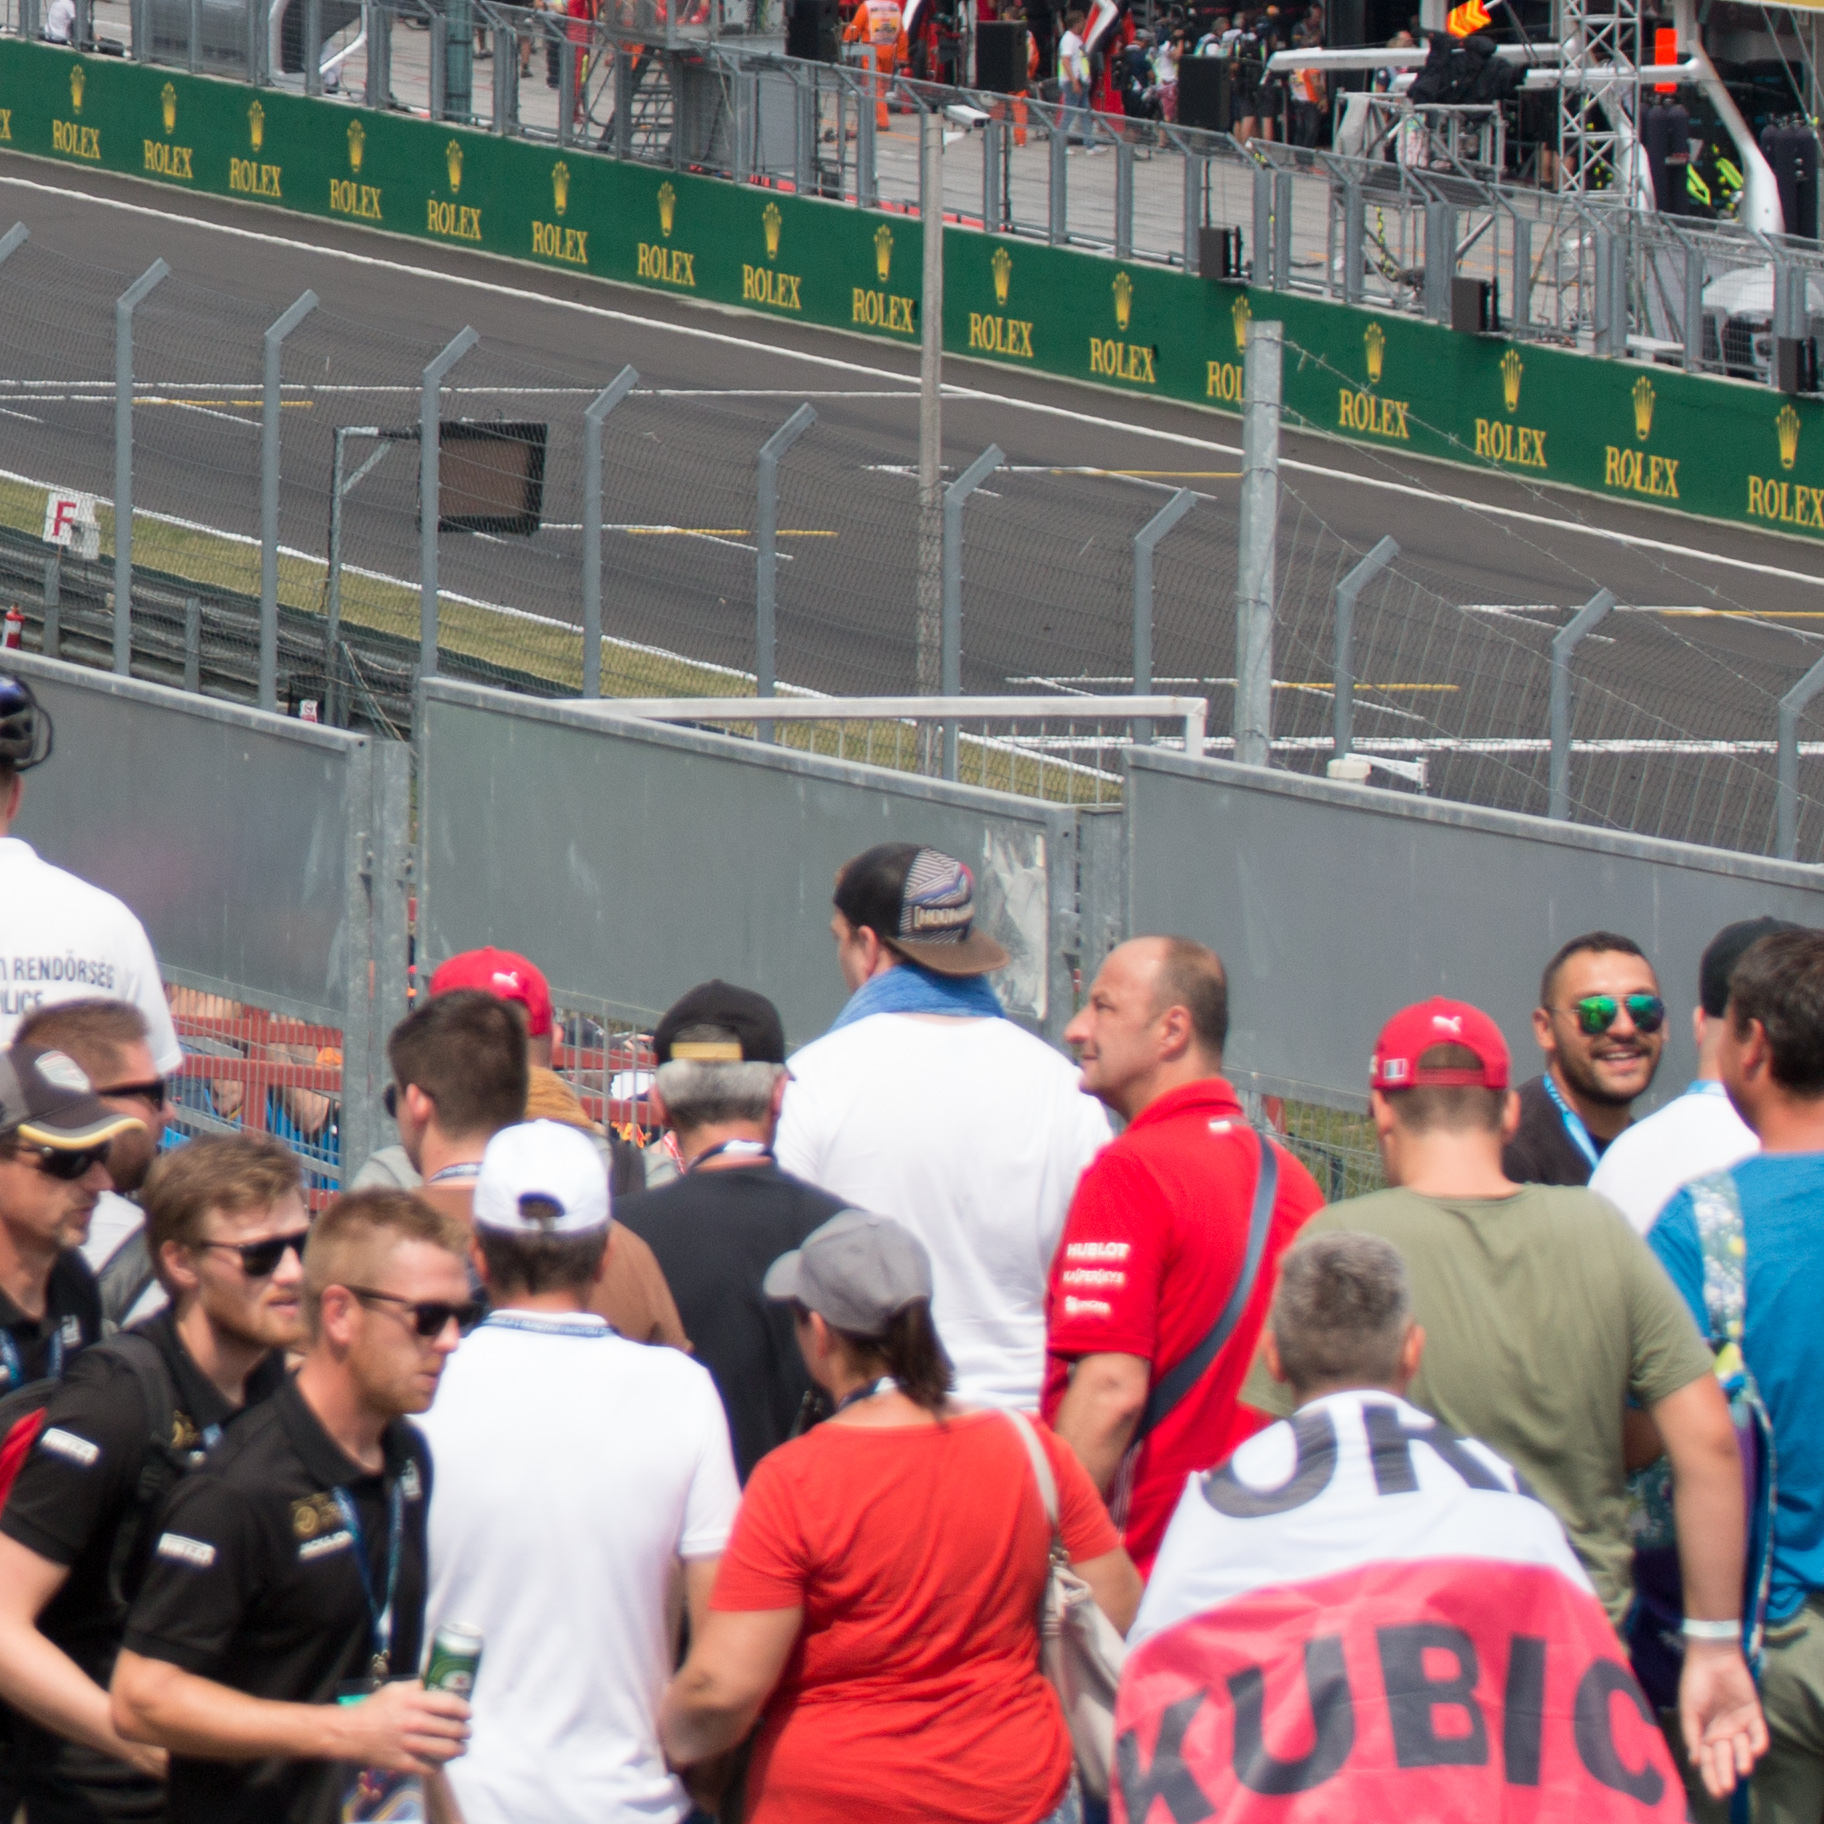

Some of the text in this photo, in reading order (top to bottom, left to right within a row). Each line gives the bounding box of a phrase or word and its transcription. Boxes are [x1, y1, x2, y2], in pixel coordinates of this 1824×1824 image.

[52, 119, 102, 160] ROLEX
[143, 139, 194, 179] ROLEX
[229, 157, 282, 198] ROLEX
[330, 178, 383, 220] ROLEX
[427, 199, 483, 241] ROLEX
[532, 220, 589, 265] ROLEX
[637, 242, 696, 287] ROLEX
[742, 263, 802, 310] ROLEX
[852, 287, 915, 334] ROLEX
[969, 312, 1035, 358] ROLEX
[1090, 337, 1157, 384] ROLEX
[1206, 360, 1243, 401] ROL
[1338, 388, 1410, 440] ROLEX
[1474, 417, 1548, 469] ROLEX
[1604, 445, 1681, 499] ROLEX
[52, 500, 77, 537] F
[1747, 474, 1824, 530] ROLEX
[14, 953, 114, 990] RENDŐRSÉG
[1066, 1242, 1131, 1262] HUBLOT
